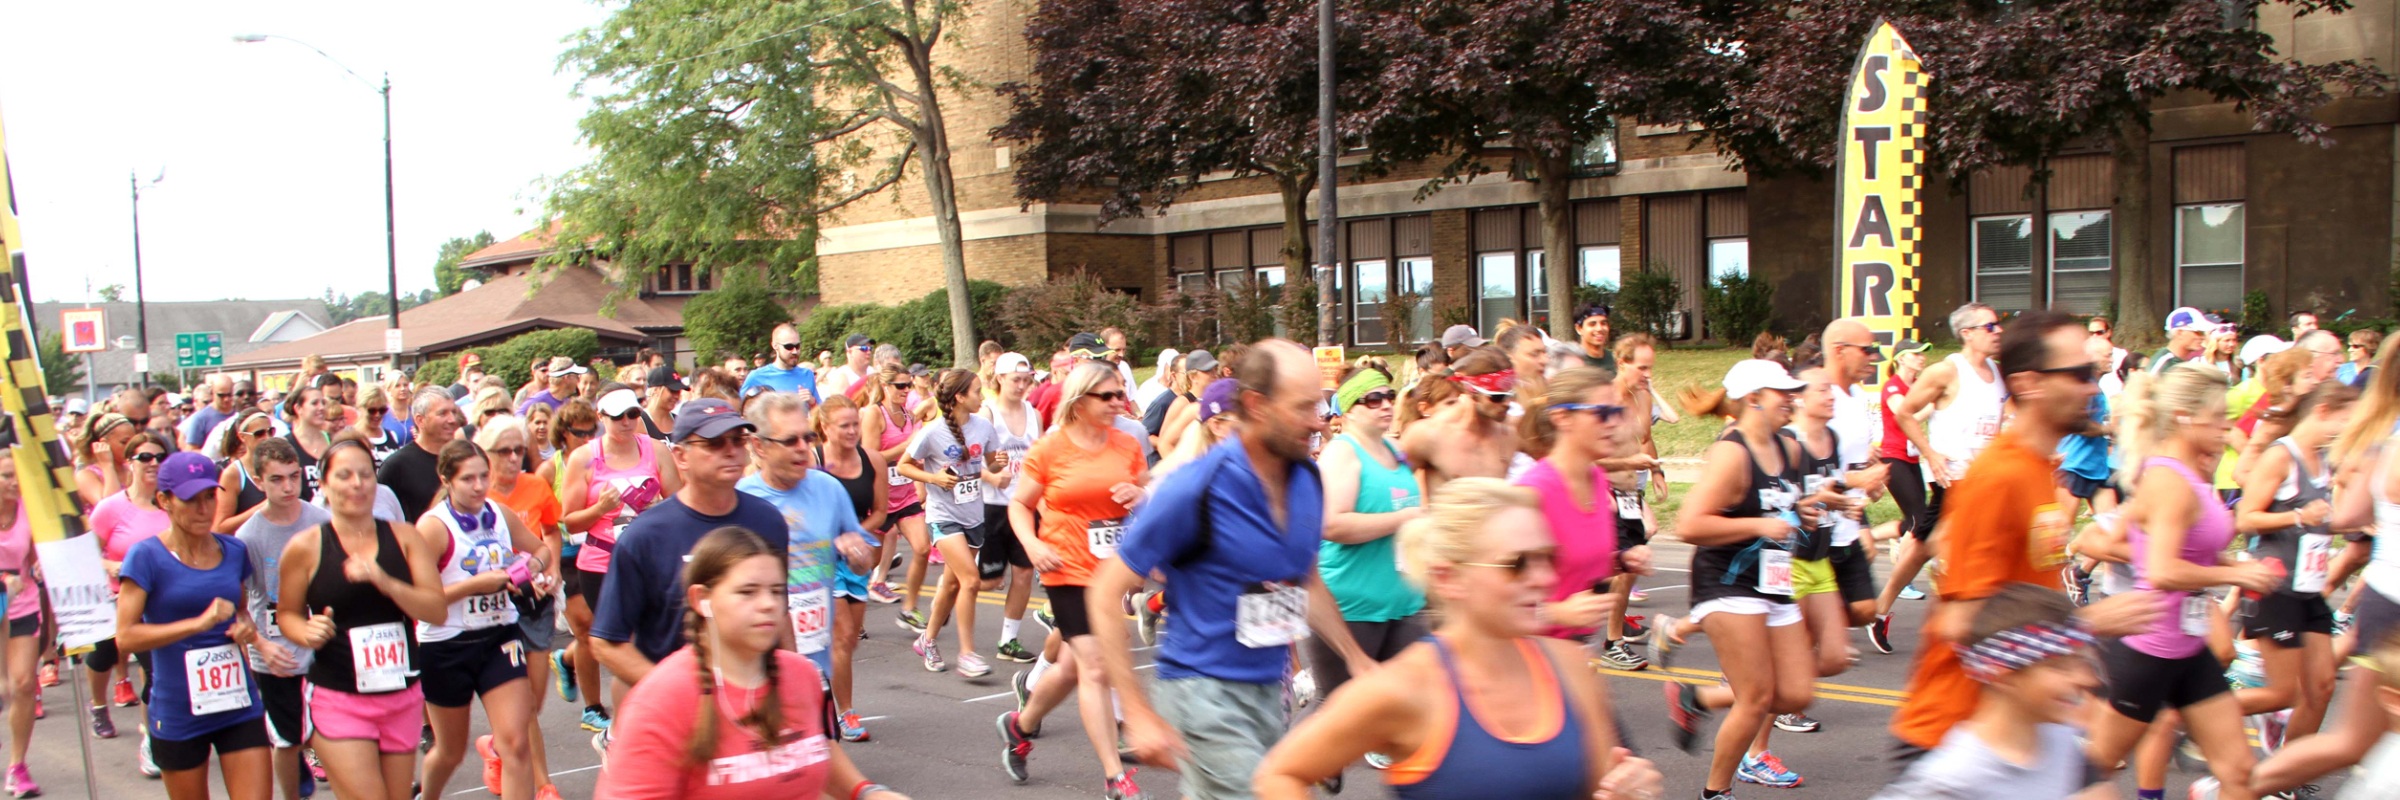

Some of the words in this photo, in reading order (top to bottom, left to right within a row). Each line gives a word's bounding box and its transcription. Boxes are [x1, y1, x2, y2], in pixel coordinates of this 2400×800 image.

[959, 481, 979, 494] 264
[468, 591, 506, 613] 1644
[211, 650, 234, 662] asics
[362, 641, 405, 669] 1847
[196, 662, 242, 692] 1877
